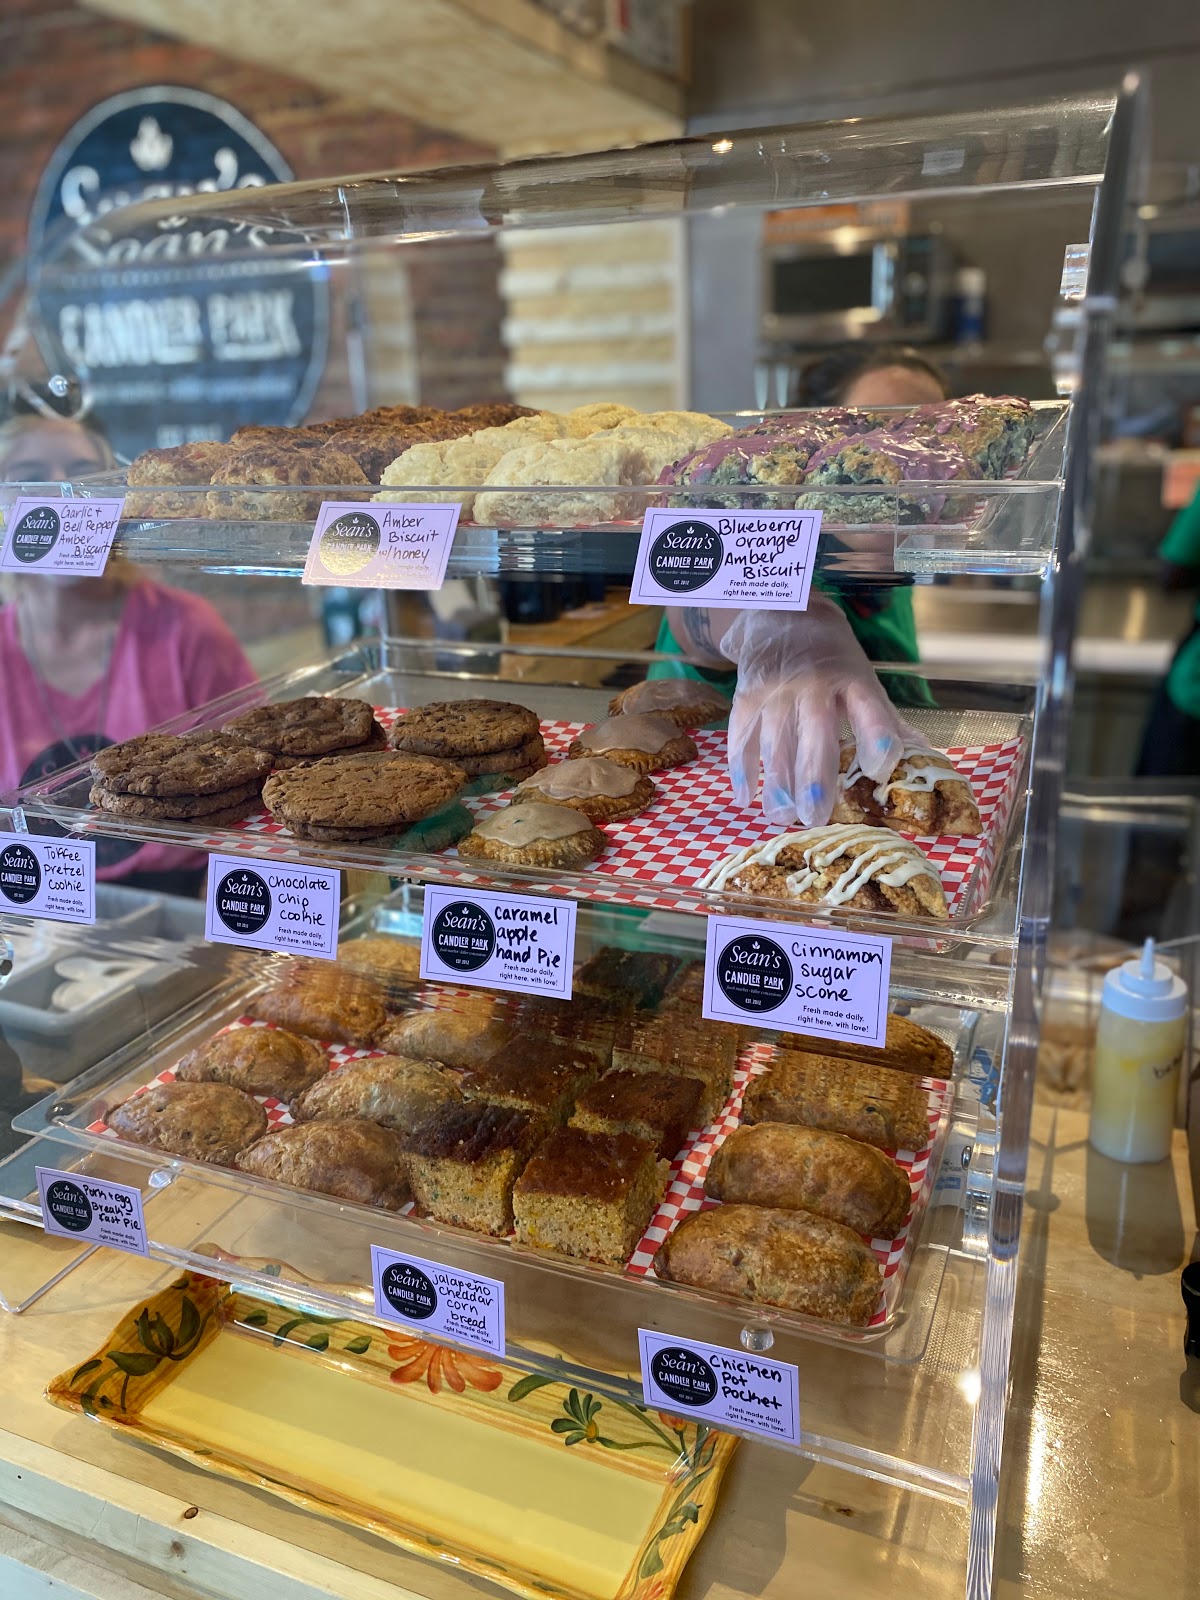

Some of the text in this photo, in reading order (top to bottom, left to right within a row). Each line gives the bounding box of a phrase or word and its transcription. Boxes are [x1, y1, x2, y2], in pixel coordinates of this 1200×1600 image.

[61, 505, 92, 518] Garlic
[382, 511, 424, 528] Amber
[23, 516, 56, 530] Sean's
[63, 520, 118, 534] Bell Pepper
[332, 522, 374, 538] Sean's
[718, 518, 802, 541] Blueberry
[16, 534, 53, 544] CANDLER PARK
[58, 534, 94, 545] Amber
[388, 530, 440, 543] Biscuit
[662, 532, 714, 550] Sean's
[75, 542, 110, 556] Biscuit
[724, 549, 780, 566] Amber
[656, 556, 714, 569] CANDLER PARK
[743, 562, 806, 580] Biscuit
[3, 853, 34, 870] Sean's
[44, 846, 81, 861] Toffee
[0, 872, 36, 886] CANDLER PARK
[48, 879, 85, 891] Cookie
[225, 878, 264, 897] Sean's
[268, 876, 330, 890] Chocolate
[222, 899, 265, 916] CANDLER PARK
[442, 911, 487, 932] Sean's
[438, 934, 488, 951] CANDLER PARK
[496, 926, 538, 946] apple
[496, 943, 531, 963] hand
[538, 948, 561, 968] Pie
[730, 945, 782, 969] Sean's
[500, 972, 513, 980] right
[520, 966, 537, 974] made
[724, 970, 784, 990] CANDLER PARK
[803, 1005, 820, 1015] Fresh
[823, 1008, 844, 1018] made
[797, 1015, 813, 1024] right
[852, 1023, 869, 1032] love!
[52, 1187, 84, 1204] Sean's
[83, 1184, 106, 1200] Pork
[114, 1193, 133, 1212] egg
[52, 1203, 74, 1215] CANDLER
[75, 1208, 88, 1218] PARK
[123, 1219, 141, 1230] Pie
[390, 1269, 427, 1291] Sean's
[388, 1286, 414, 1301] CANDLER
[416, 1294, 432, 1307] PARK
[447, 1299, 478, 1315] corn
[446, 1319, 460, 1328] Fresh
[461, 1324, 476, 1332] made
[451, 1311, 486, 1330] bread
[443, 1325, 455, 1333] right
[481, 1336, 494, 1345] love!
[661, 1353, 706, 1376] Sean's
[658, 1371, 690, 1387] CANDLER
[693, 1379, 710, 1392] PARK
[728, 1404, 744, 1414] Fresh
[746, 1410, 763, 1418] made
[726, 1412, 739, 1420] right
[771, 1424, 786, 1433] love!
